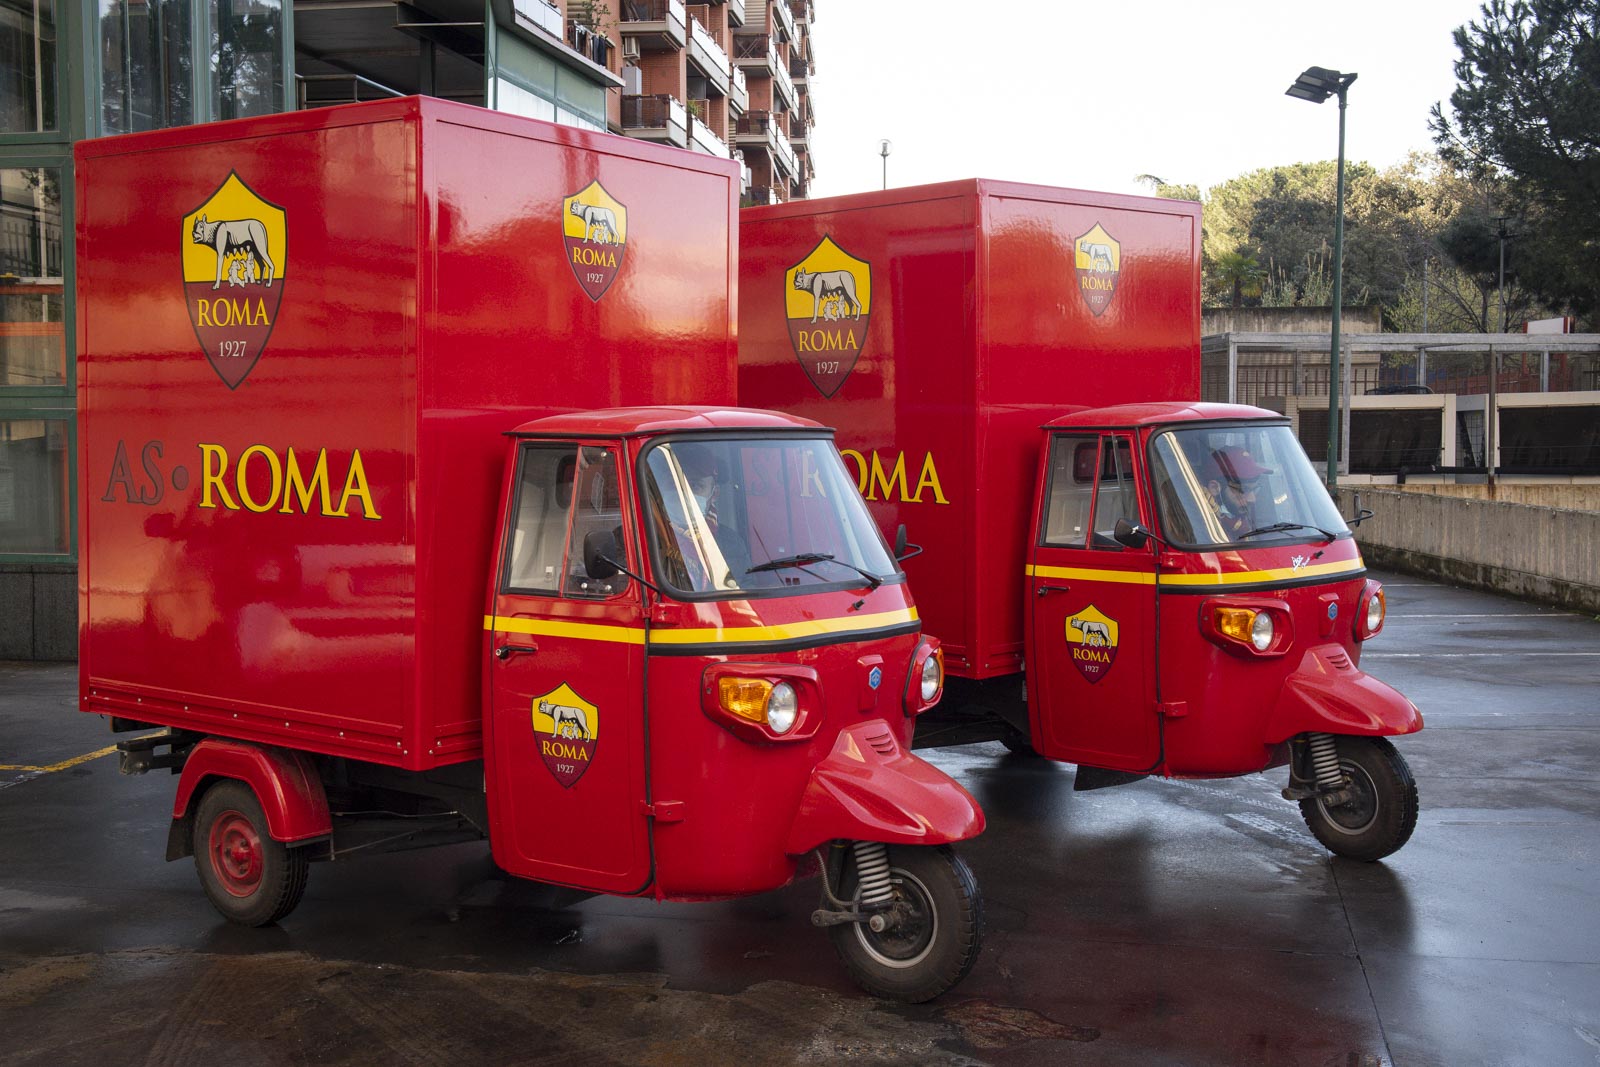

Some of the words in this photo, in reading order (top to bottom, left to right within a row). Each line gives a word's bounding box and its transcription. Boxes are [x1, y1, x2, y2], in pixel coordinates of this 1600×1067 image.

[573, 246, 616, 267] ROMA
[587, 273, 603, 283] 1927
[1082, 276, 1113, 290] ROMA
[197, 297, 270, 326] ROMA
[218, 340, 247, 357] 1927
[798, 329, 859, 351] ROMA
[816, 361, 839, 375] 1927
[198, 443, 382, 520] ROMA
[1073, 647, 1110, 663] ROMA
[542, 741, 588, 760] ROMA
[557, 764, 574, 773] 1927
